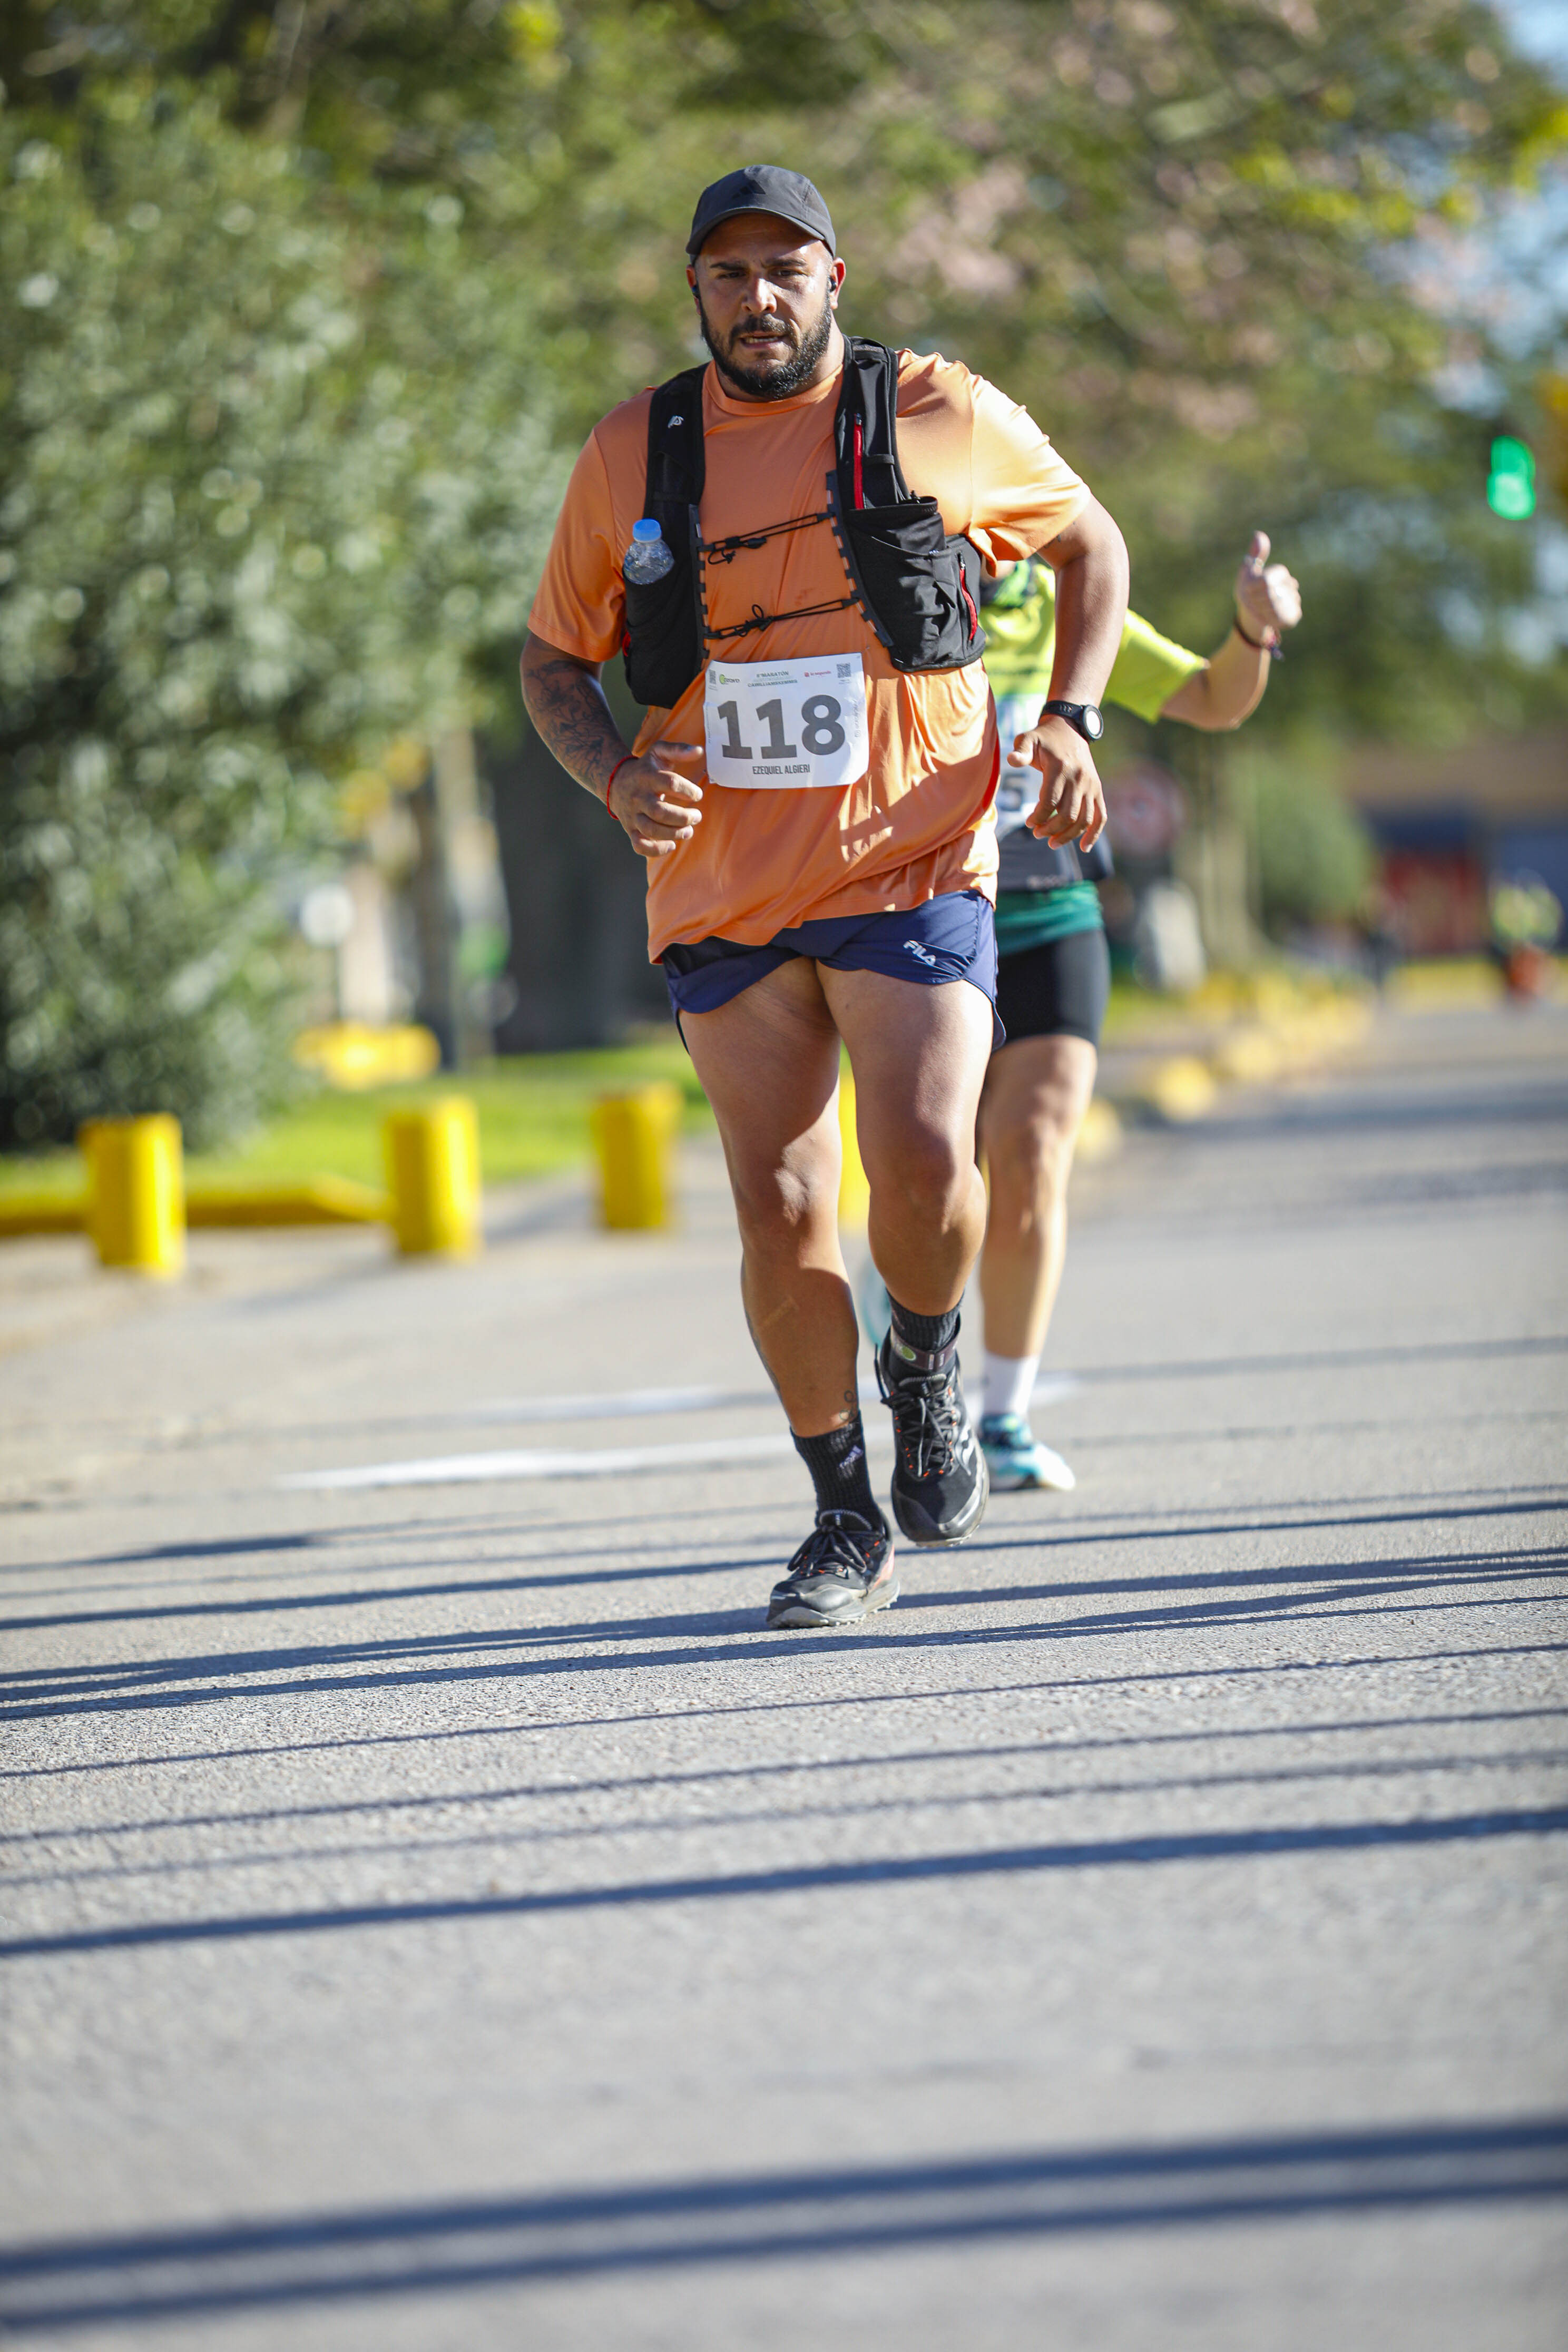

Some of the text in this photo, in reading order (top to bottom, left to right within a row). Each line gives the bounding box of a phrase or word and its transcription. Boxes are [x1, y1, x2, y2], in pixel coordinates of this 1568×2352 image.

[717, 694, 846, 759] 118
[752, 763, 810, 775] EZEQUIEL ALGIERI
[903, 939, 936, 966] FILA
